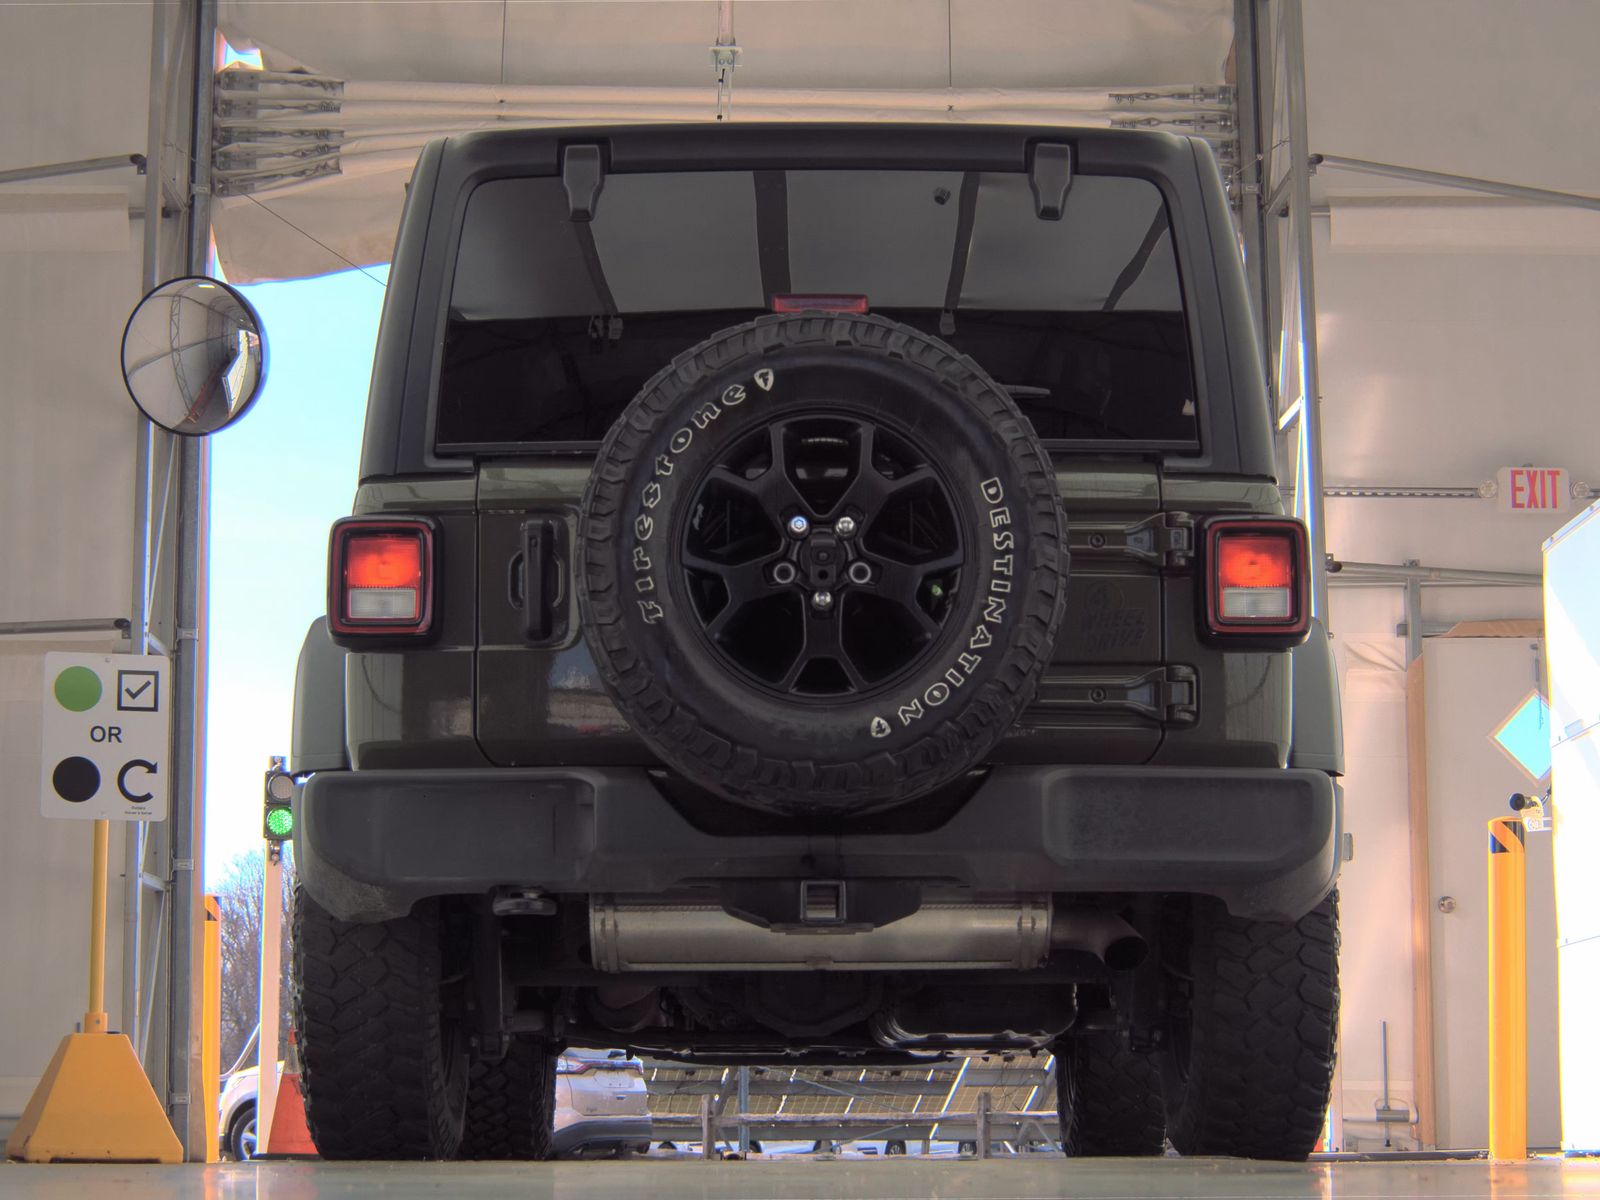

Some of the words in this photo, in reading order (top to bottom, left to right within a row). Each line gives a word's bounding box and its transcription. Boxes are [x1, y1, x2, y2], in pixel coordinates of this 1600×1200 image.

[633, 384, 747, 624] Firestone
[1510, 470, 1560, 508] EXIT
[898, 476, 1014, 726] DESTINATION
[89, 725, 123, 743] OR
